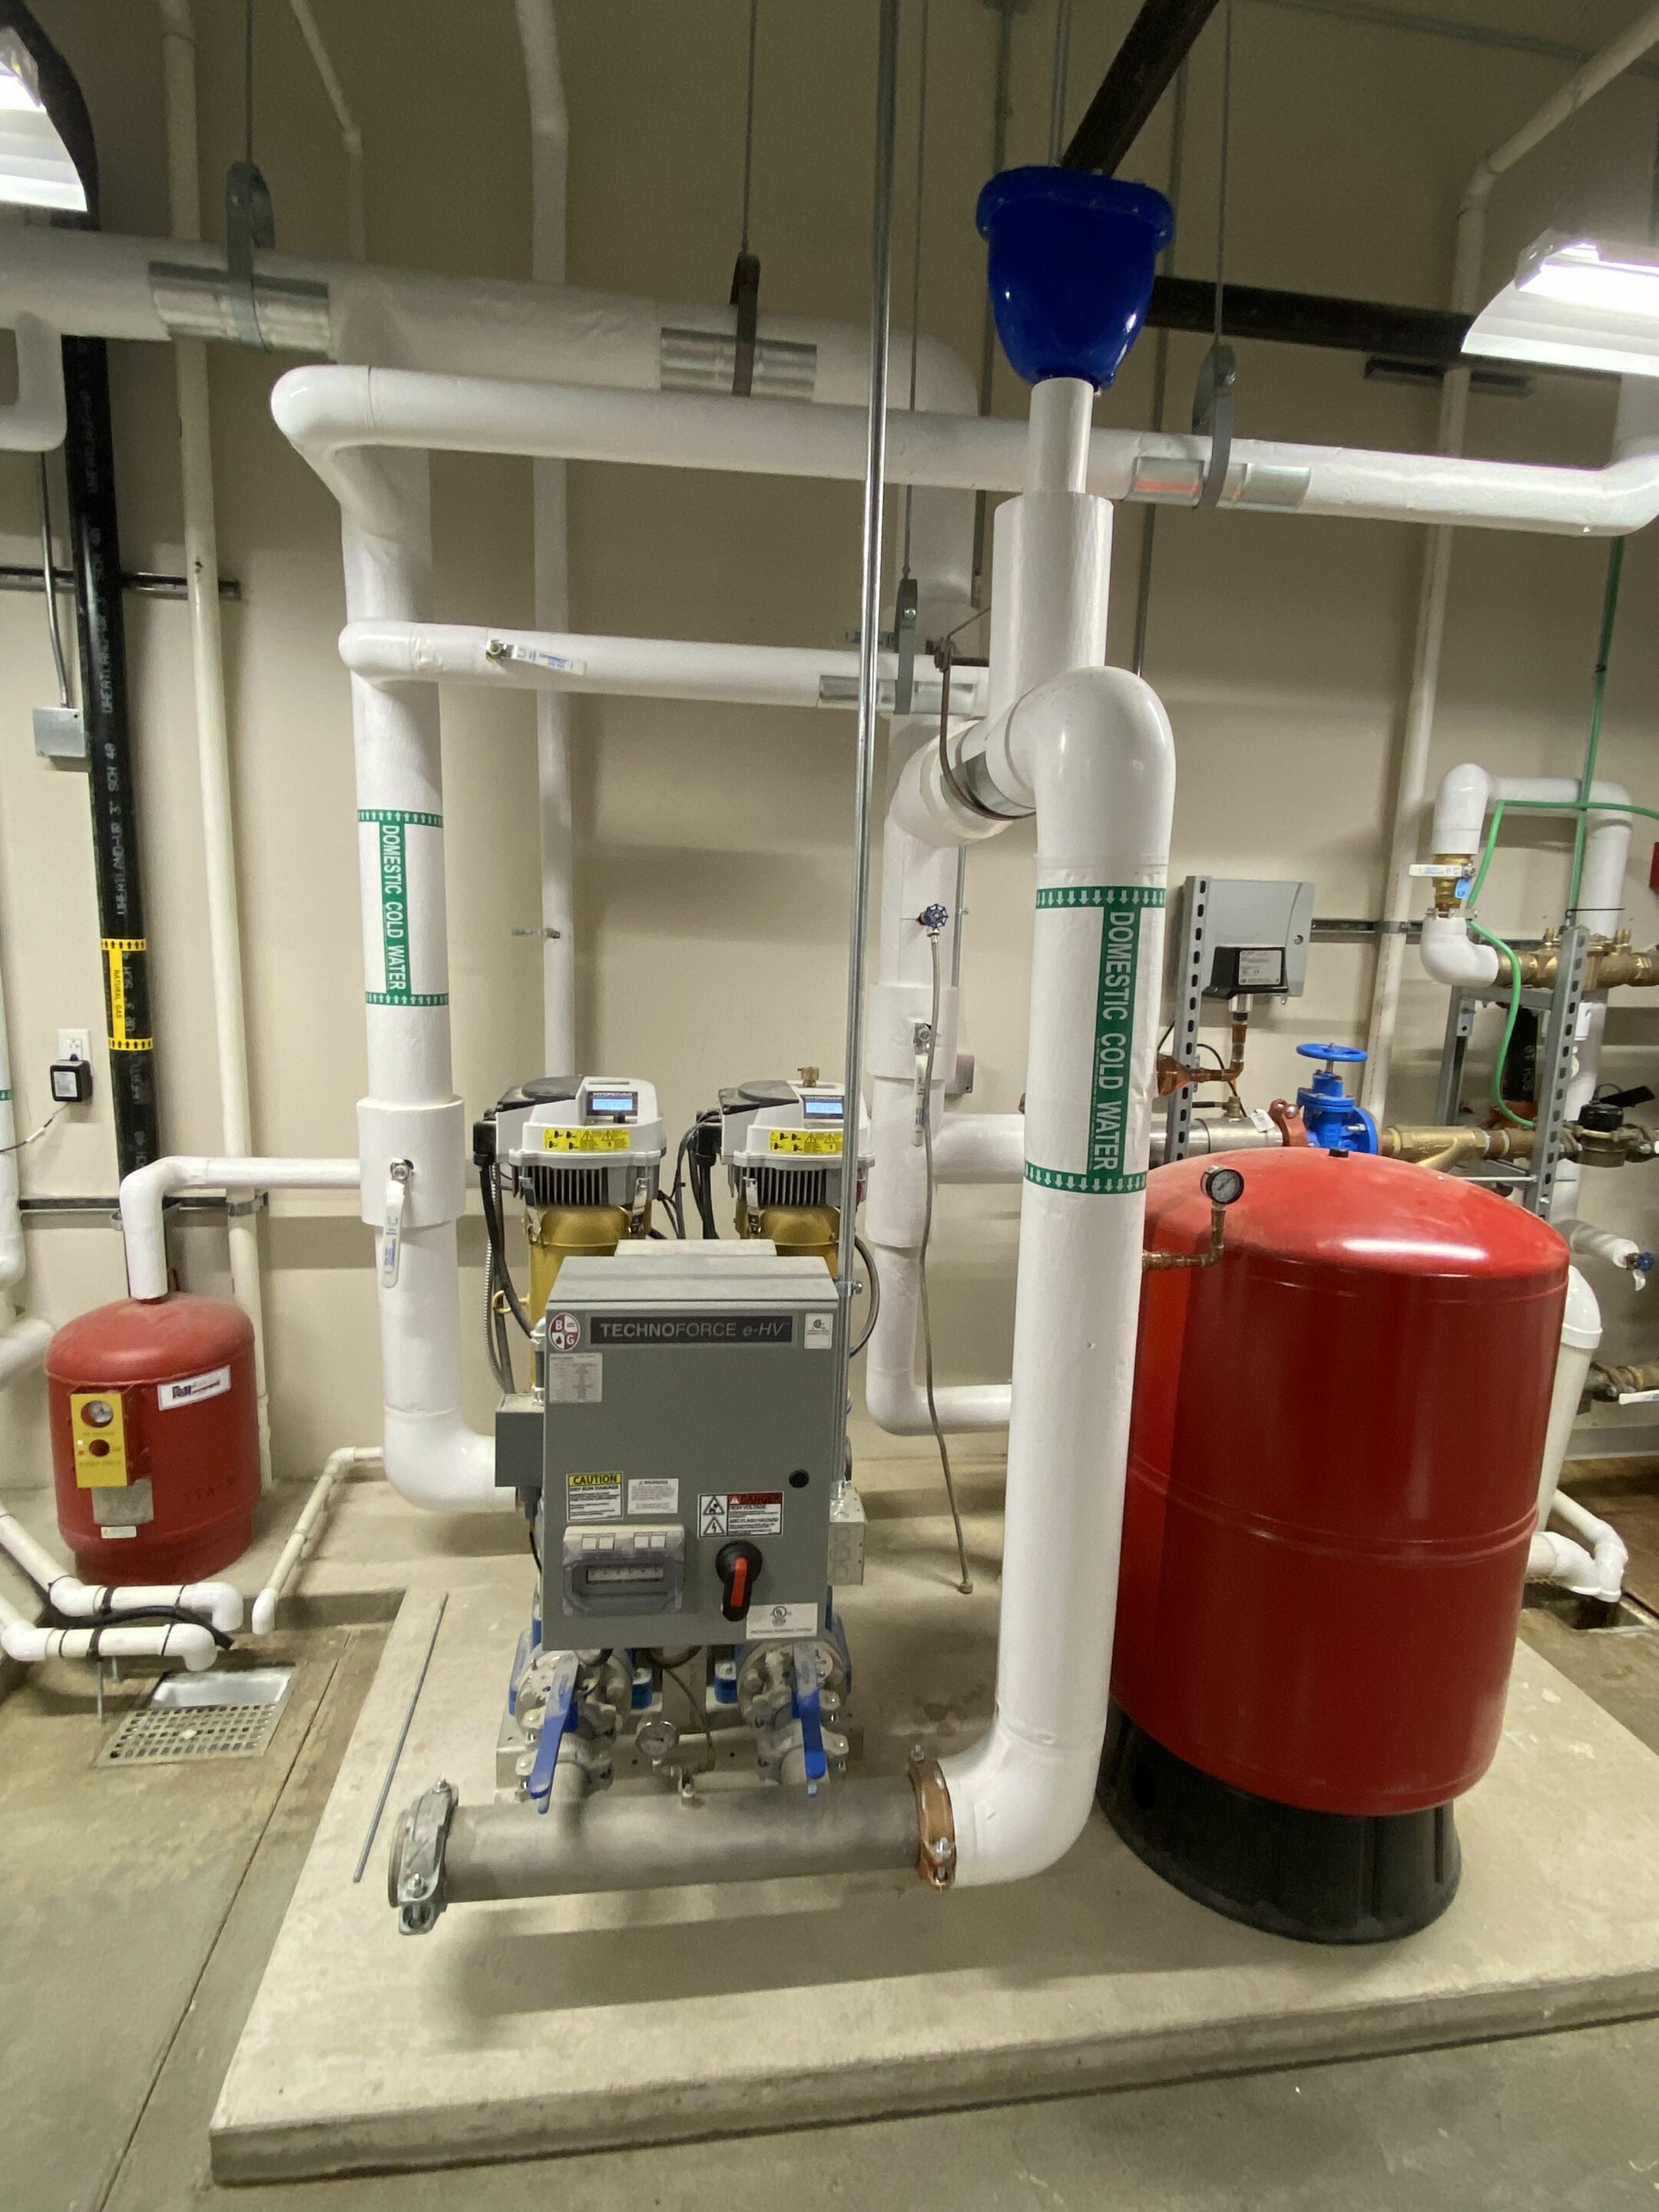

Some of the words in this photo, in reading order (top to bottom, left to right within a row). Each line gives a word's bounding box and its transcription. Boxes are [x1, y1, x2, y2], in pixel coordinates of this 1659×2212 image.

[104, 742, 116, 760] 40
[106, 767, 119, 792] SCH
[382, 825, 402, 894] DOMESTIC
[385, 901, 404, 939] COLD
[387, 945, 406, 990] WATER
[1101, 911, 1135, 1021] DOMESTIC
[113, 969, 123, 1001] NATURAL
[114, 1005, 123, 1018] GAS
[1099, 1032, 1126, 1090] COLD
[1092, 1100, 1122, 1171] WATER
[555, 1320, 563, 1331] B
[566, 1333, 575, 1345] G
[600, 1323, 737, 1338] TECHNOFORCE
[573, 1474, 618, 1485] CAUTION
